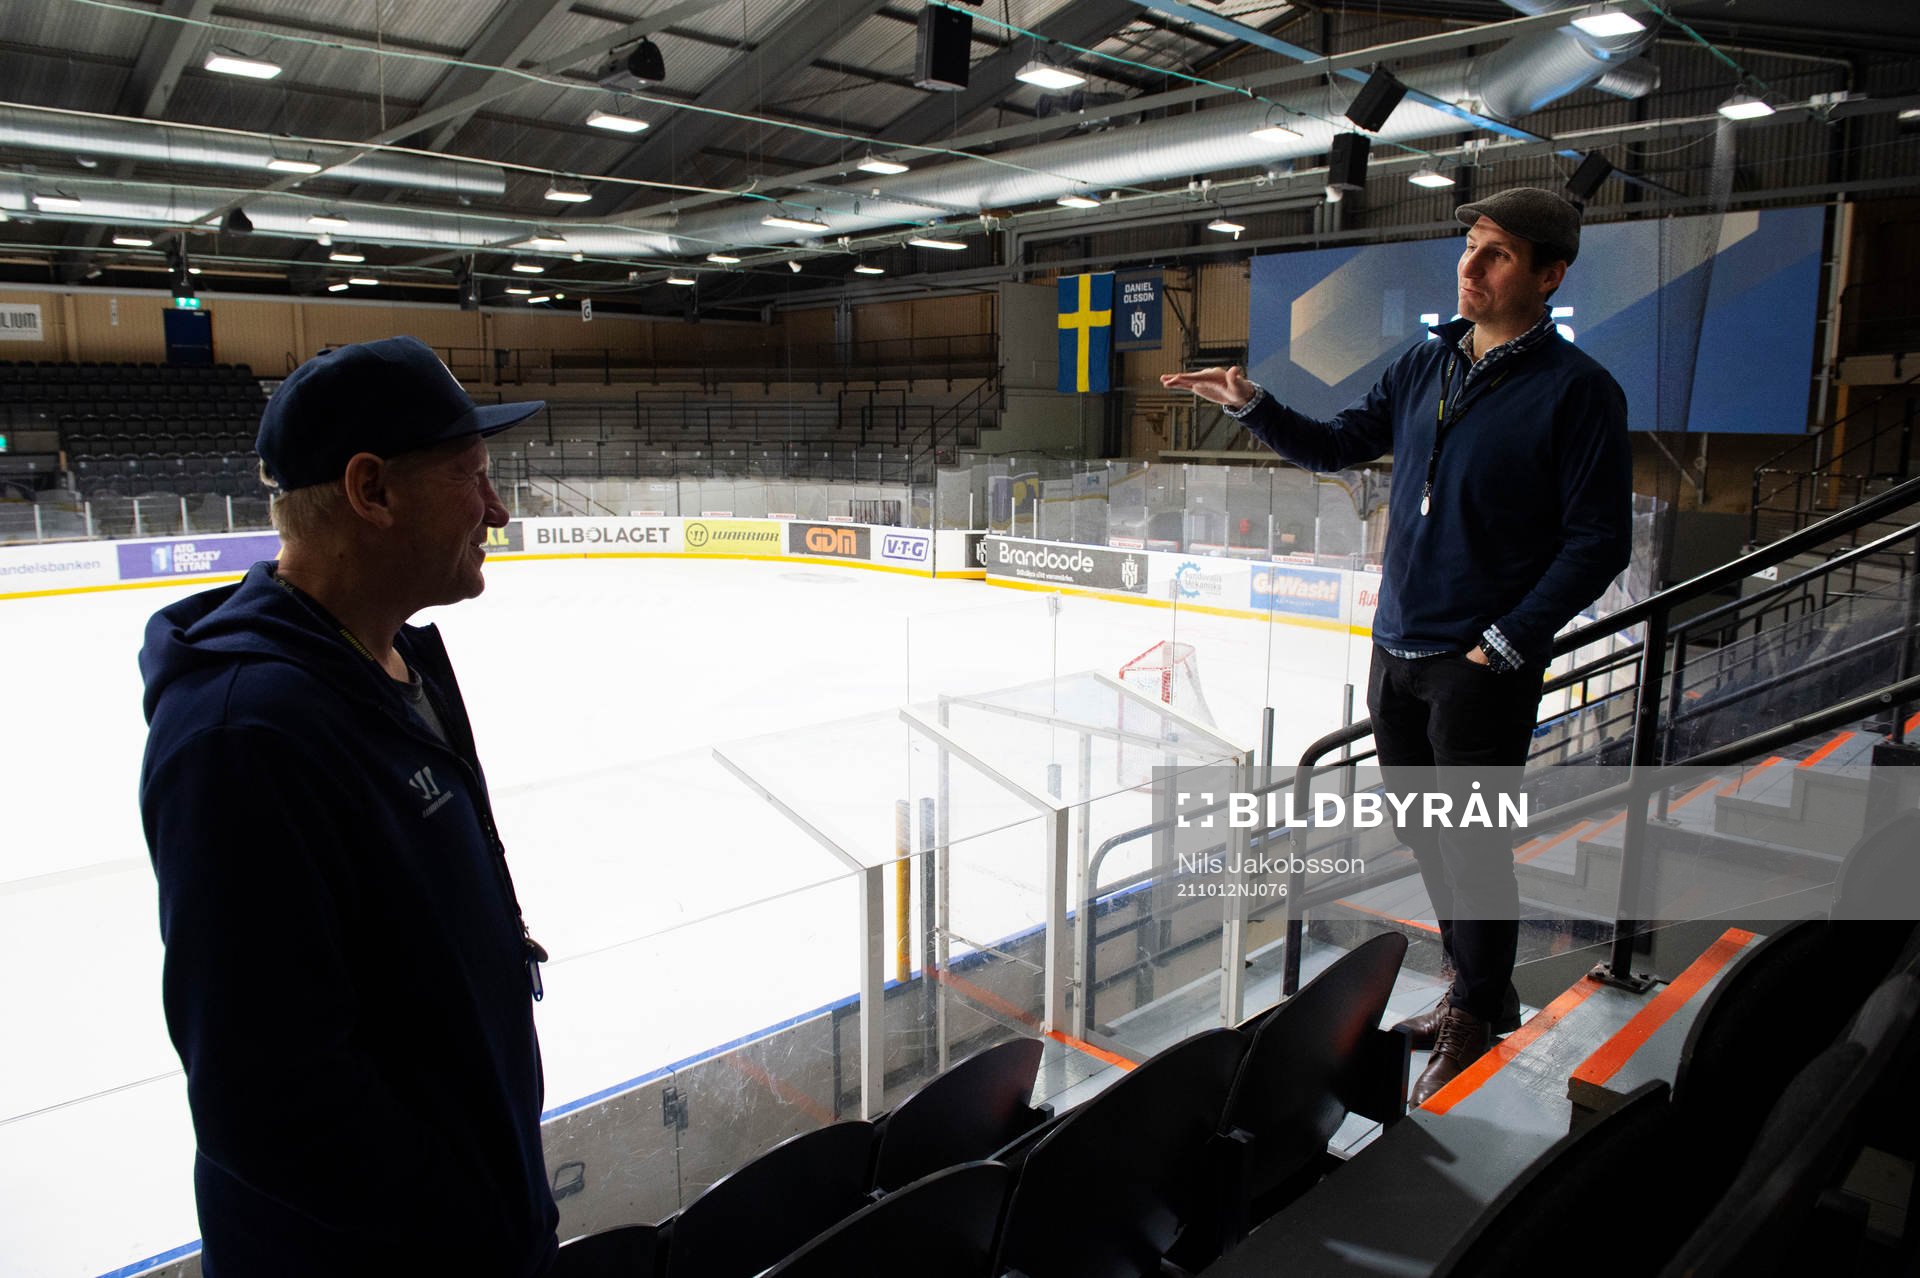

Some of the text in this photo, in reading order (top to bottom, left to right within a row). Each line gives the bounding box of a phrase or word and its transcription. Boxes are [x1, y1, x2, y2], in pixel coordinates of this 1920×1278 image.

[1125, 282, 1153, 293] DANIEL
[1123, 292, 1154, 304] OLSSON
[583, 305, 591, 319] G
[537, 527, 671, 544] BILBOLAGET
[712, 530, 779, 542] WARRIOR
[805, 527, 857, 555] GDM
[173, 551, 221, 563] HOCKEY
[1000, 542, 1095, 573] Brandcode
[174, 561, 211, 573] ETTAN
